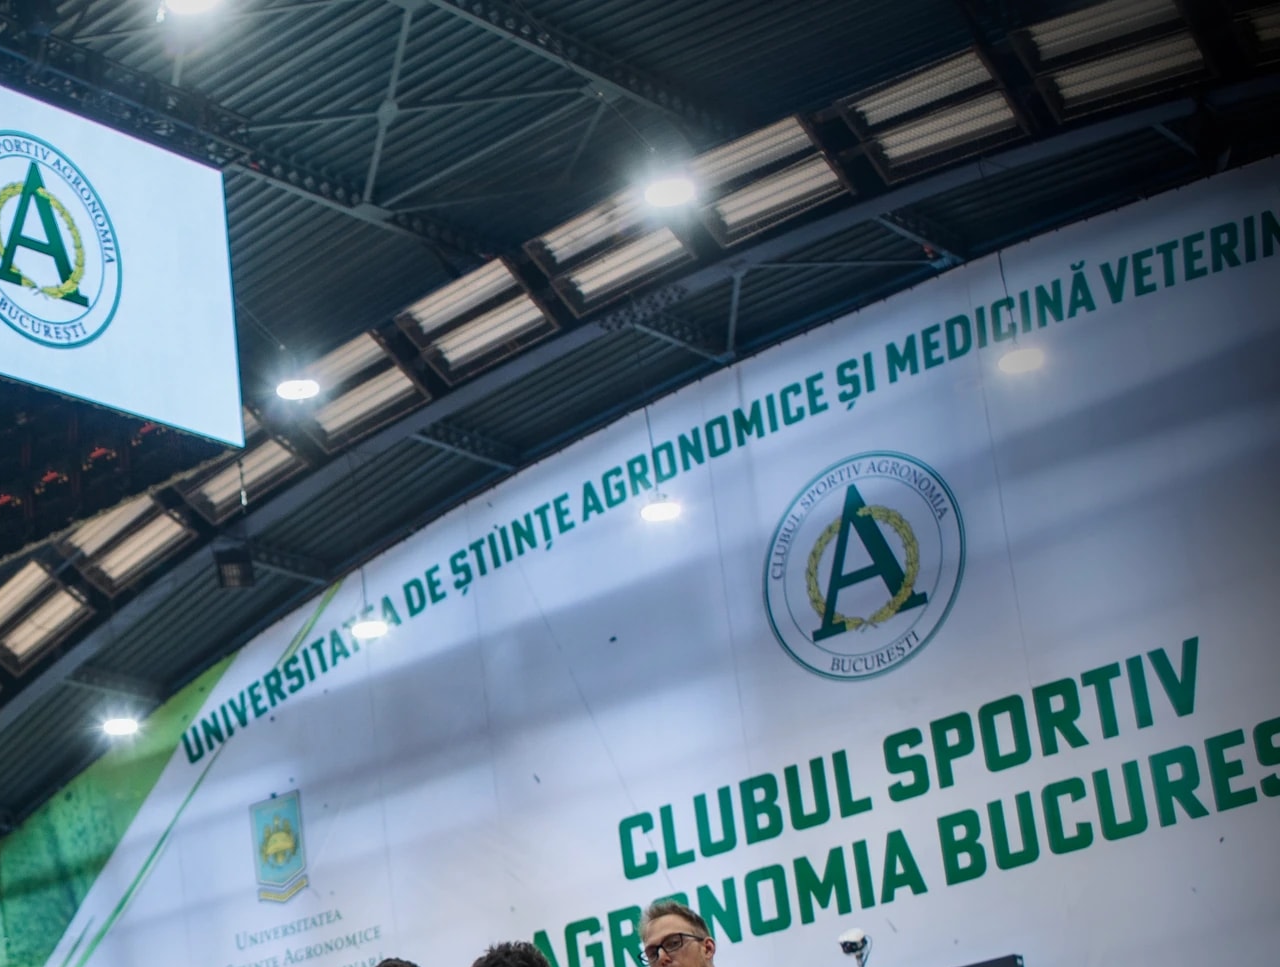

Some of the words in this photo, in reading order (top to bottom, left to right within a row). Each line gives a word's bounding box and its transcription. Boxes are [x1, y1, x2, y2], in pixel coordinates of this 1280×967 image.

[52, 158, 115, 264] AGRONOMIA
[402, 564, 447, 618] DE
[581, 371, 830, 522] AGRONOMICE
[836, 351, 876, 411] ȘI
[885, 259, 1097, 384] MEDICINĂ
[770, 512, 803, 581] CLUBUL
[800, 461, 863, 511] SPORTIV
[866, 459, 949, 521] AGRONOMIA
[618, 749, 872, 881] CLUBUL
[881, 635, 1200, 803] SPORTIV
